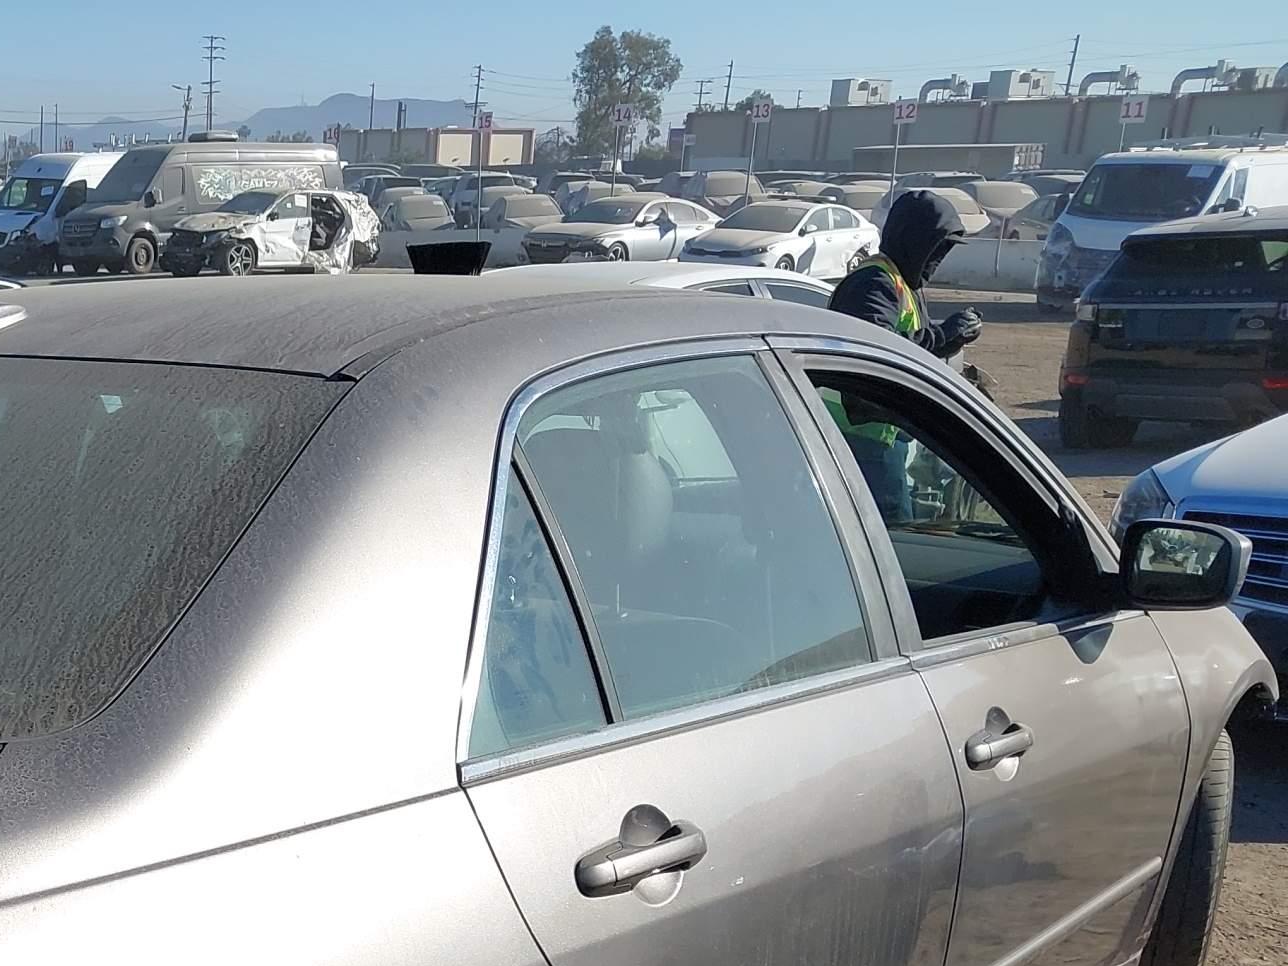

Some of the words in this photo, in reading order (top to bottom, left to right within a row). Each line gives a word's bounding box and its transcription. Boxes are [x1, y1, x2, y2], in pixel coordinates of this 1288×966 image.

[615, 107, 632, 121] 14
[753, 103, 770, 118] 13
[895, 103, 916, 119] 12
[1122, 101, 1145, 119] 11
[478, 115, 492, 129] 15
